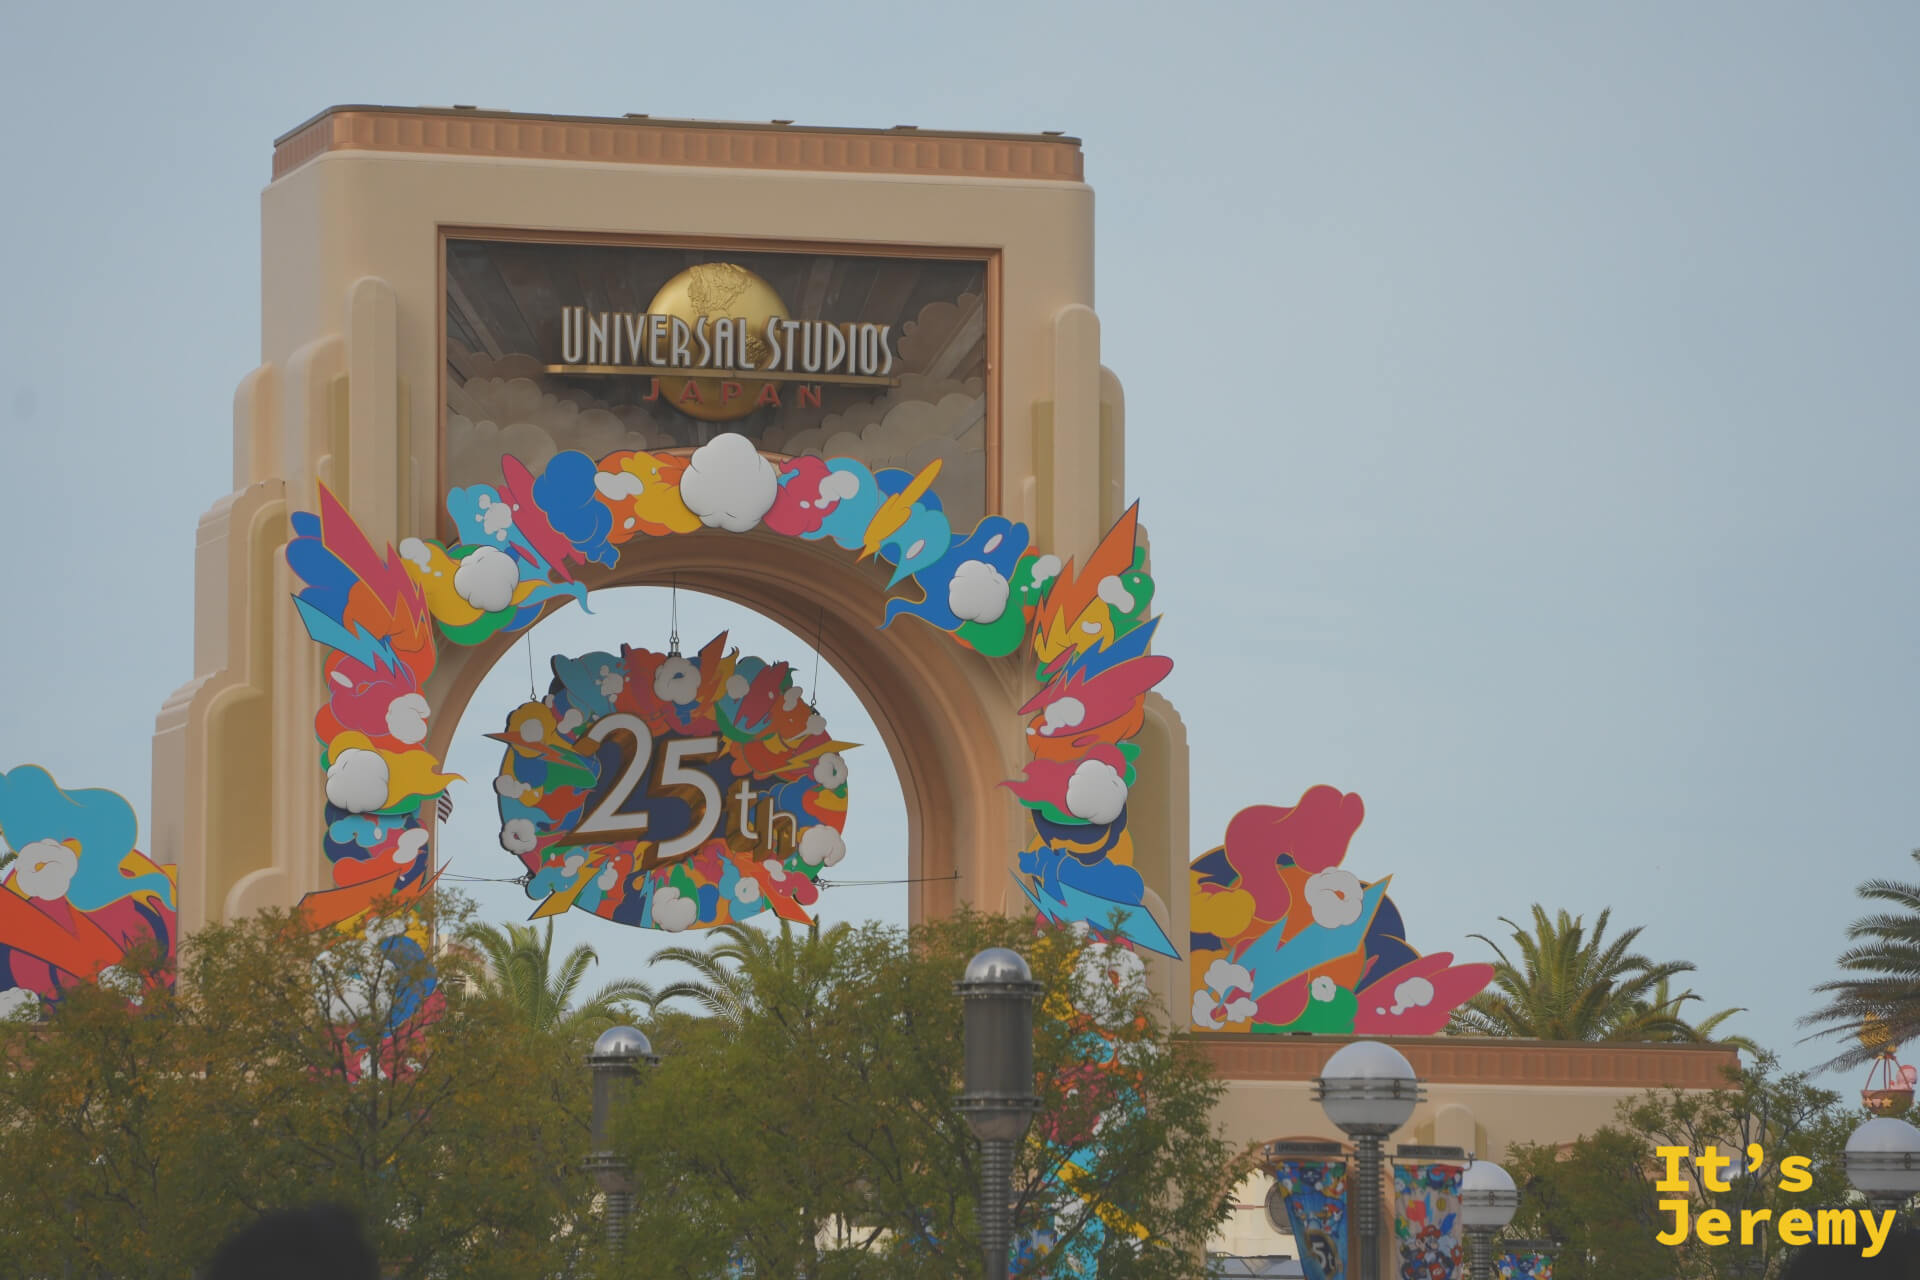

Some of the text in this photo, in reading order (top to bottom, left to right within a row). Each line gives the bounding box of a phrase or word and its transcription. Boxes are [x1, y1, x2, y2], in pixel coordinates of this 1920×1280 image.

[561, 306, 893, 376] UNIVERSAL STUDIOS
[642, 378, 822, 409] JAPAN
[573, 712, 798, 859] 25th
